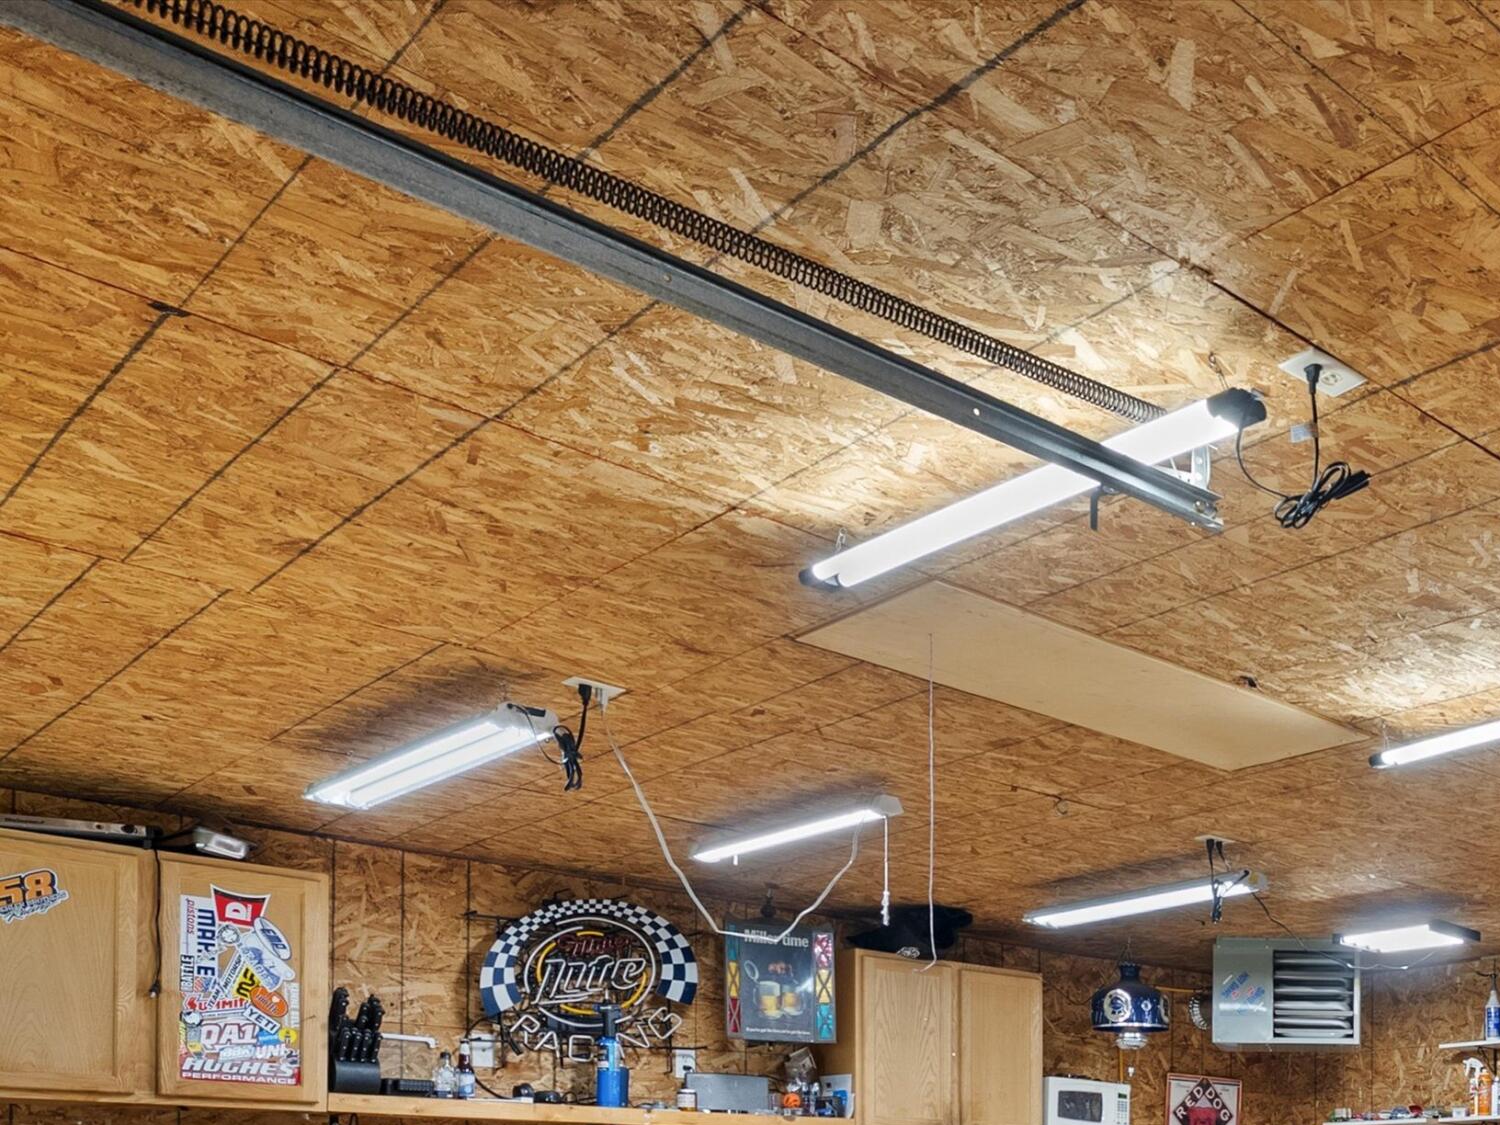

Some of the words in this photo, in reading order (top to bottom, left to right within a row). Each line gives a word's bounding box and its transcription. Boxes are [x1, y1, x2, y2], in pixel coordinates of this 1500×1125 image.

[782, 933, 809, 947] time
[531, 955, 647, 1004] Lite
[248, 1007, 278, 1031] YETI
[201, 1023, 258, 1049] QA1
[510, 1007, 682, 1062] RACNG
[182, 1057, 294, 1076] HUGHES
[182, 1072, 297, 1084] PERFORMANCE
[1175, 1086, 1203, 1119] RED
[1205, 1087, 1230, 1121] DOG
